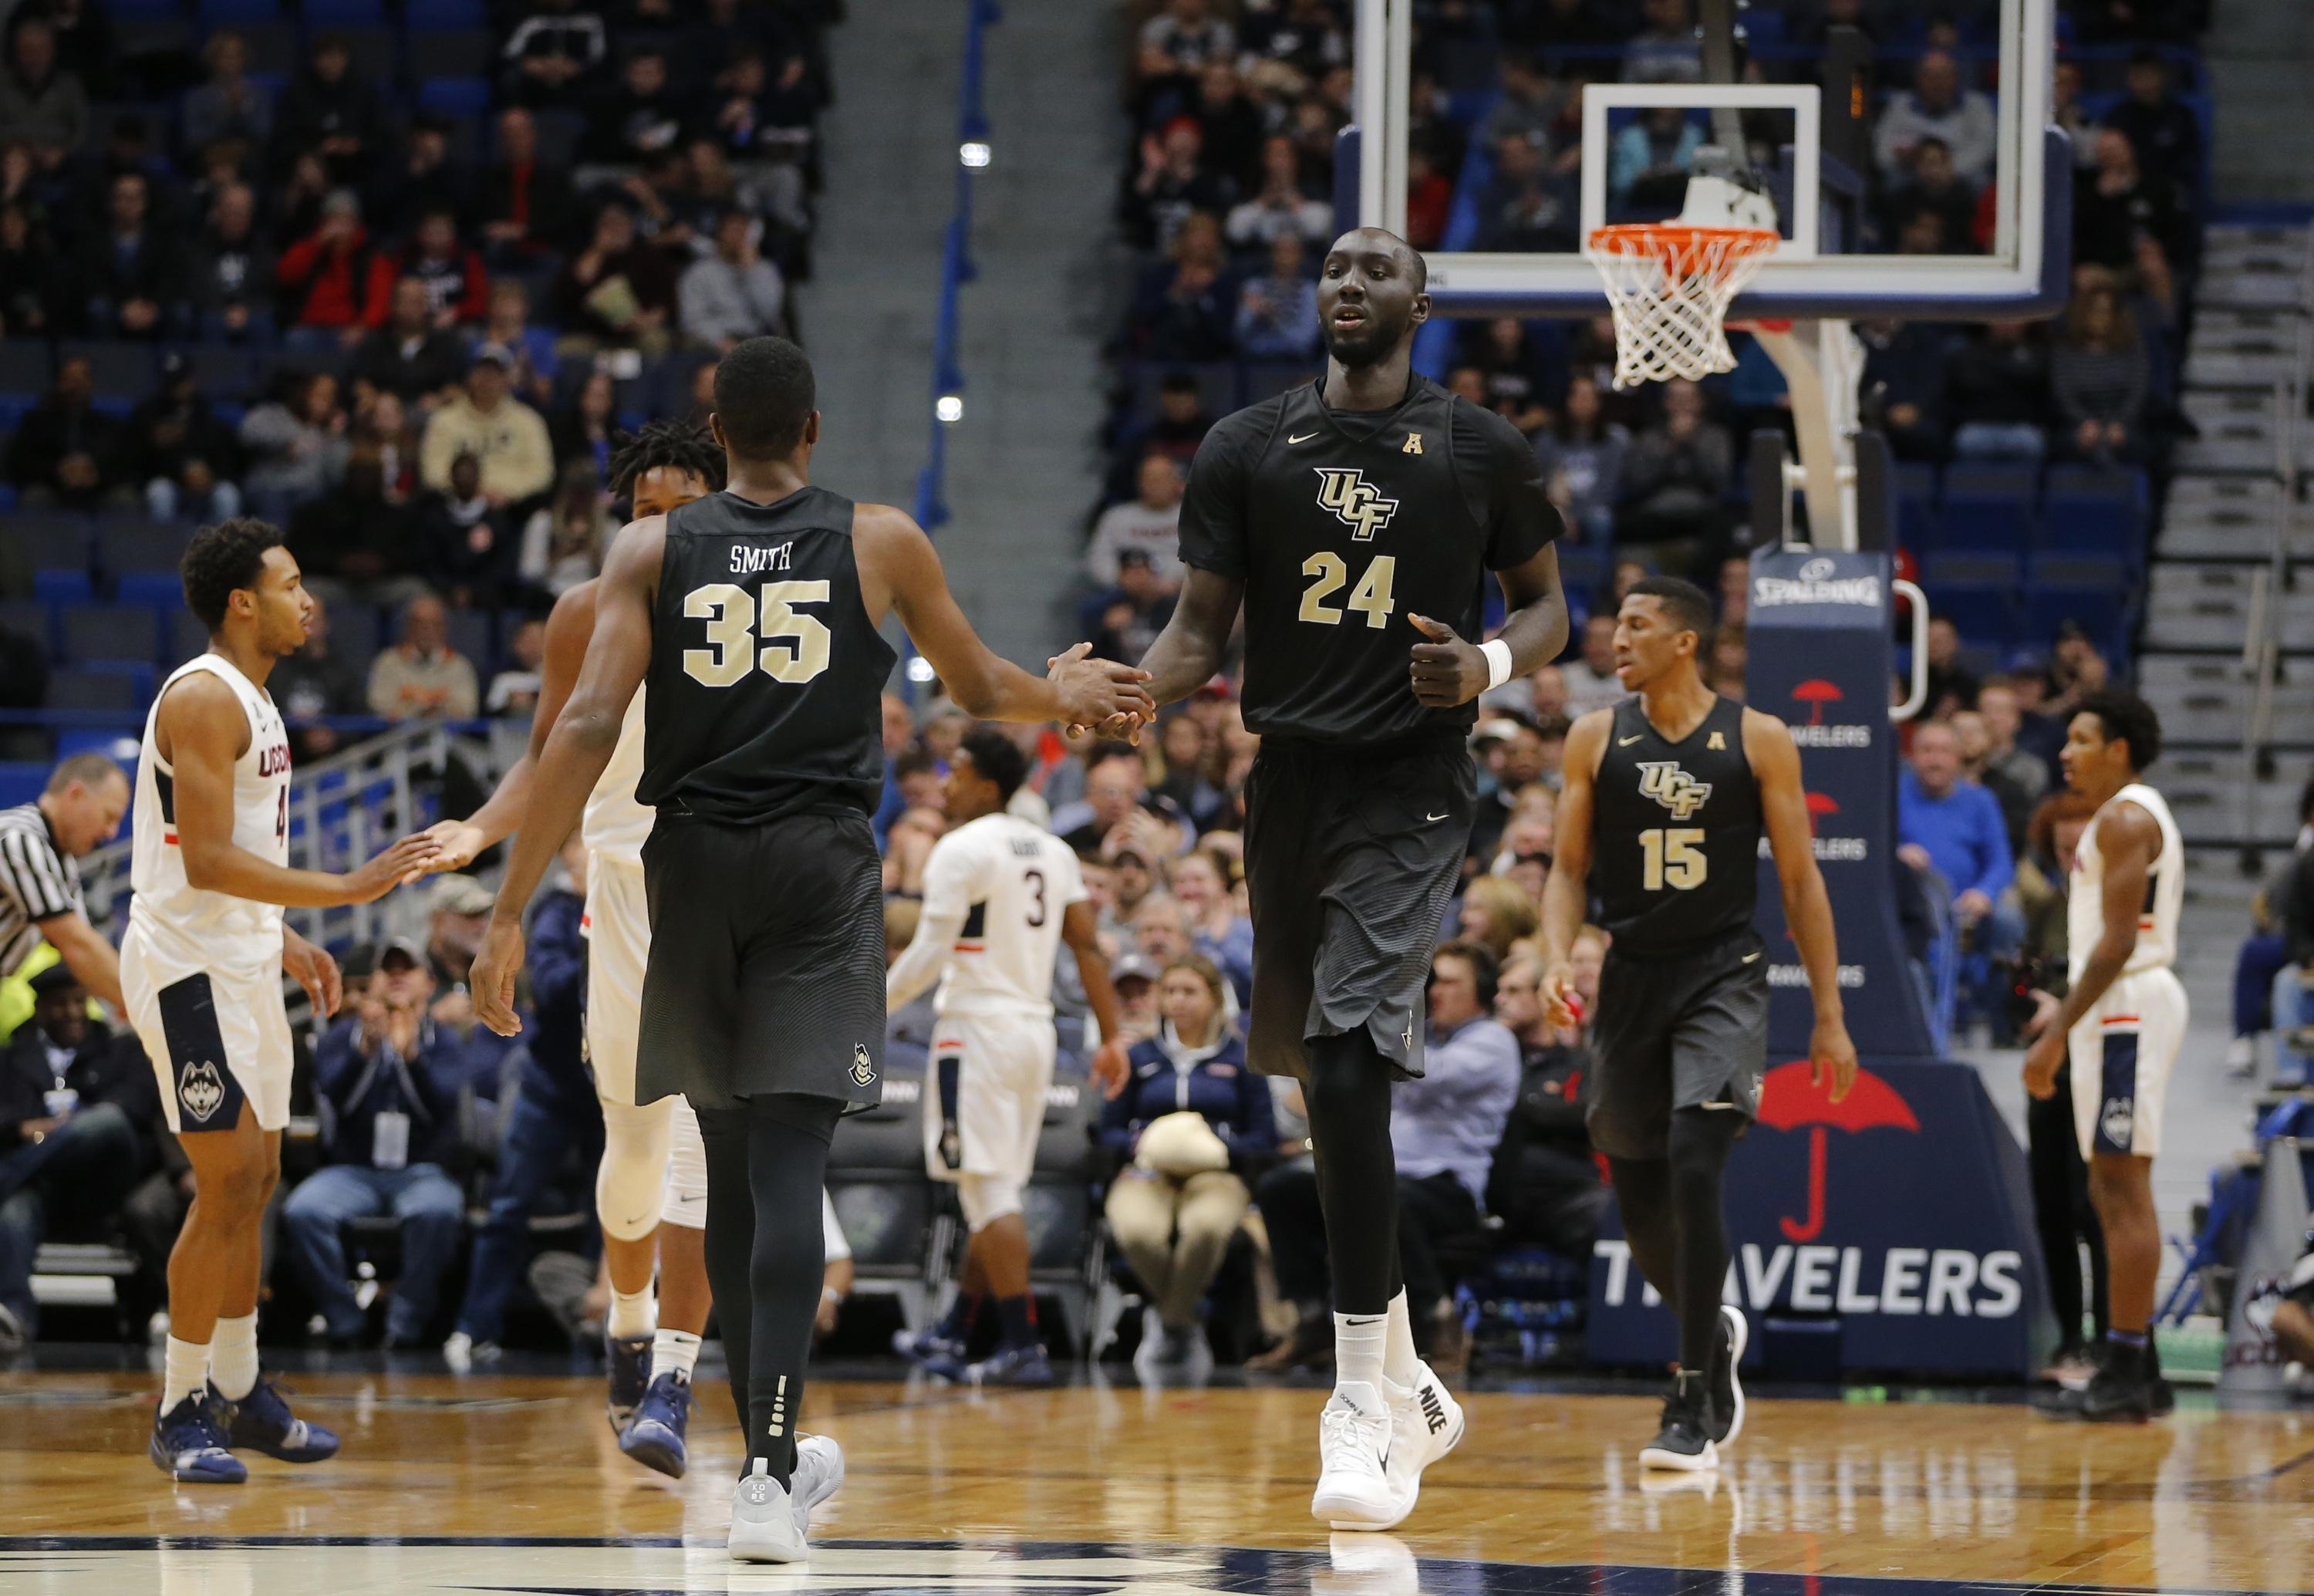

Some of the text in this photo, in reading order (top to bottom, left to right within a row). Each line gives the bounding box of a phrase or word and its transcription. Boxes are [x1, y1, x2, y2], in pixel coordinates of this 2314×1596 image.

[1402, 432, 1423, 454] A
[1314, 467, 1399, 542] UCF
[730, 542, 793, 573] SMITH
[1298, 552, 1395, 629] 24
[1754, 576, 1880, 607] SPALDING
[683, 580, 831, 687] 35
[1635, 761, 1713, 820] UCF
[1638, 828, 1707, 890] 15
[1024, 870, 1045, 927] 3
[1594, 1240, 2022, 1317] TVELERS
[1418, 1385, 1447, 1436] NIKE
